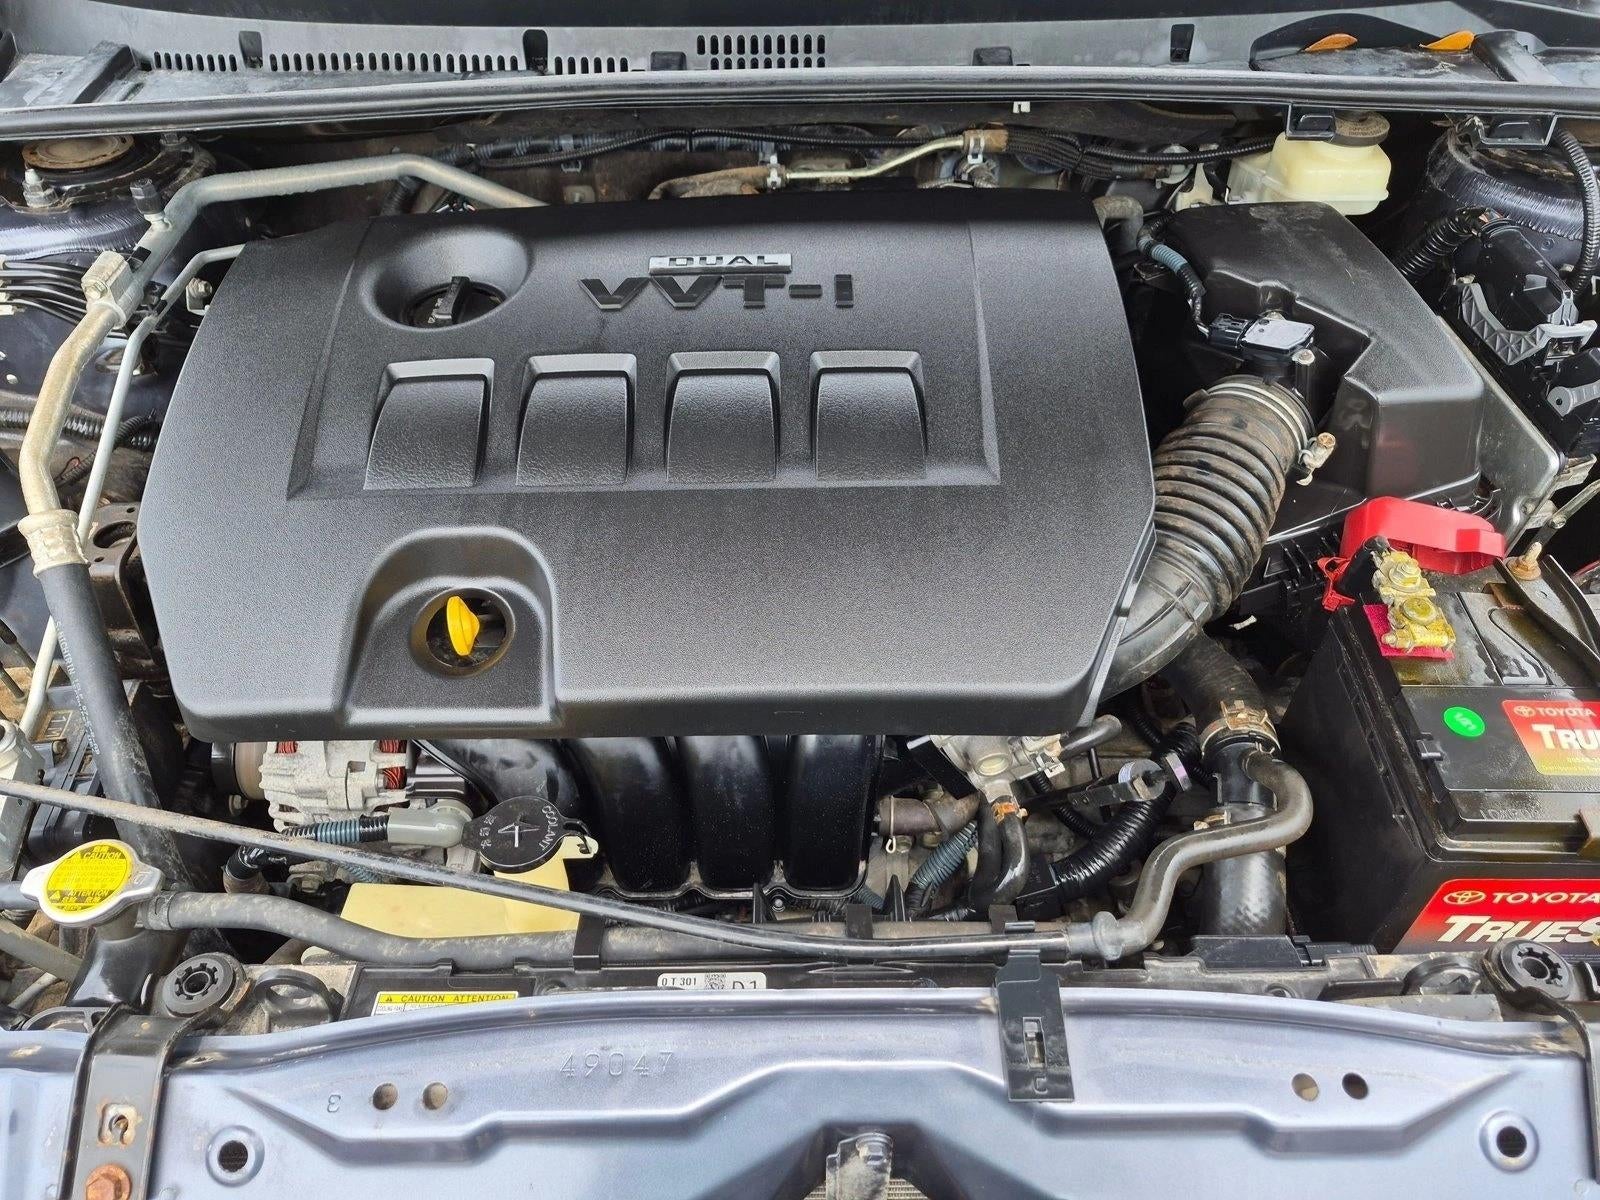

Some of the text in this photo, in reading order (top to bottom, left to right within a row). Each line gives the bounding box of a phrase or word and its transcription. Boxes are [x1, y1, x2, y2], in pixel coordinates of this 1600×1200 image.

[668, 255, 779, 266] DUAL
[1535, 707, 1597, 717] TOYOTA
[1531, 723, 1600, 750] TRU
[539, 805, 558, 850] COOLANT
[1492, 892, 1600, 904] TOYOTA
[400, 995, 445, 1003] CAUTION
[559, 1050, 673, 1078] 49047
